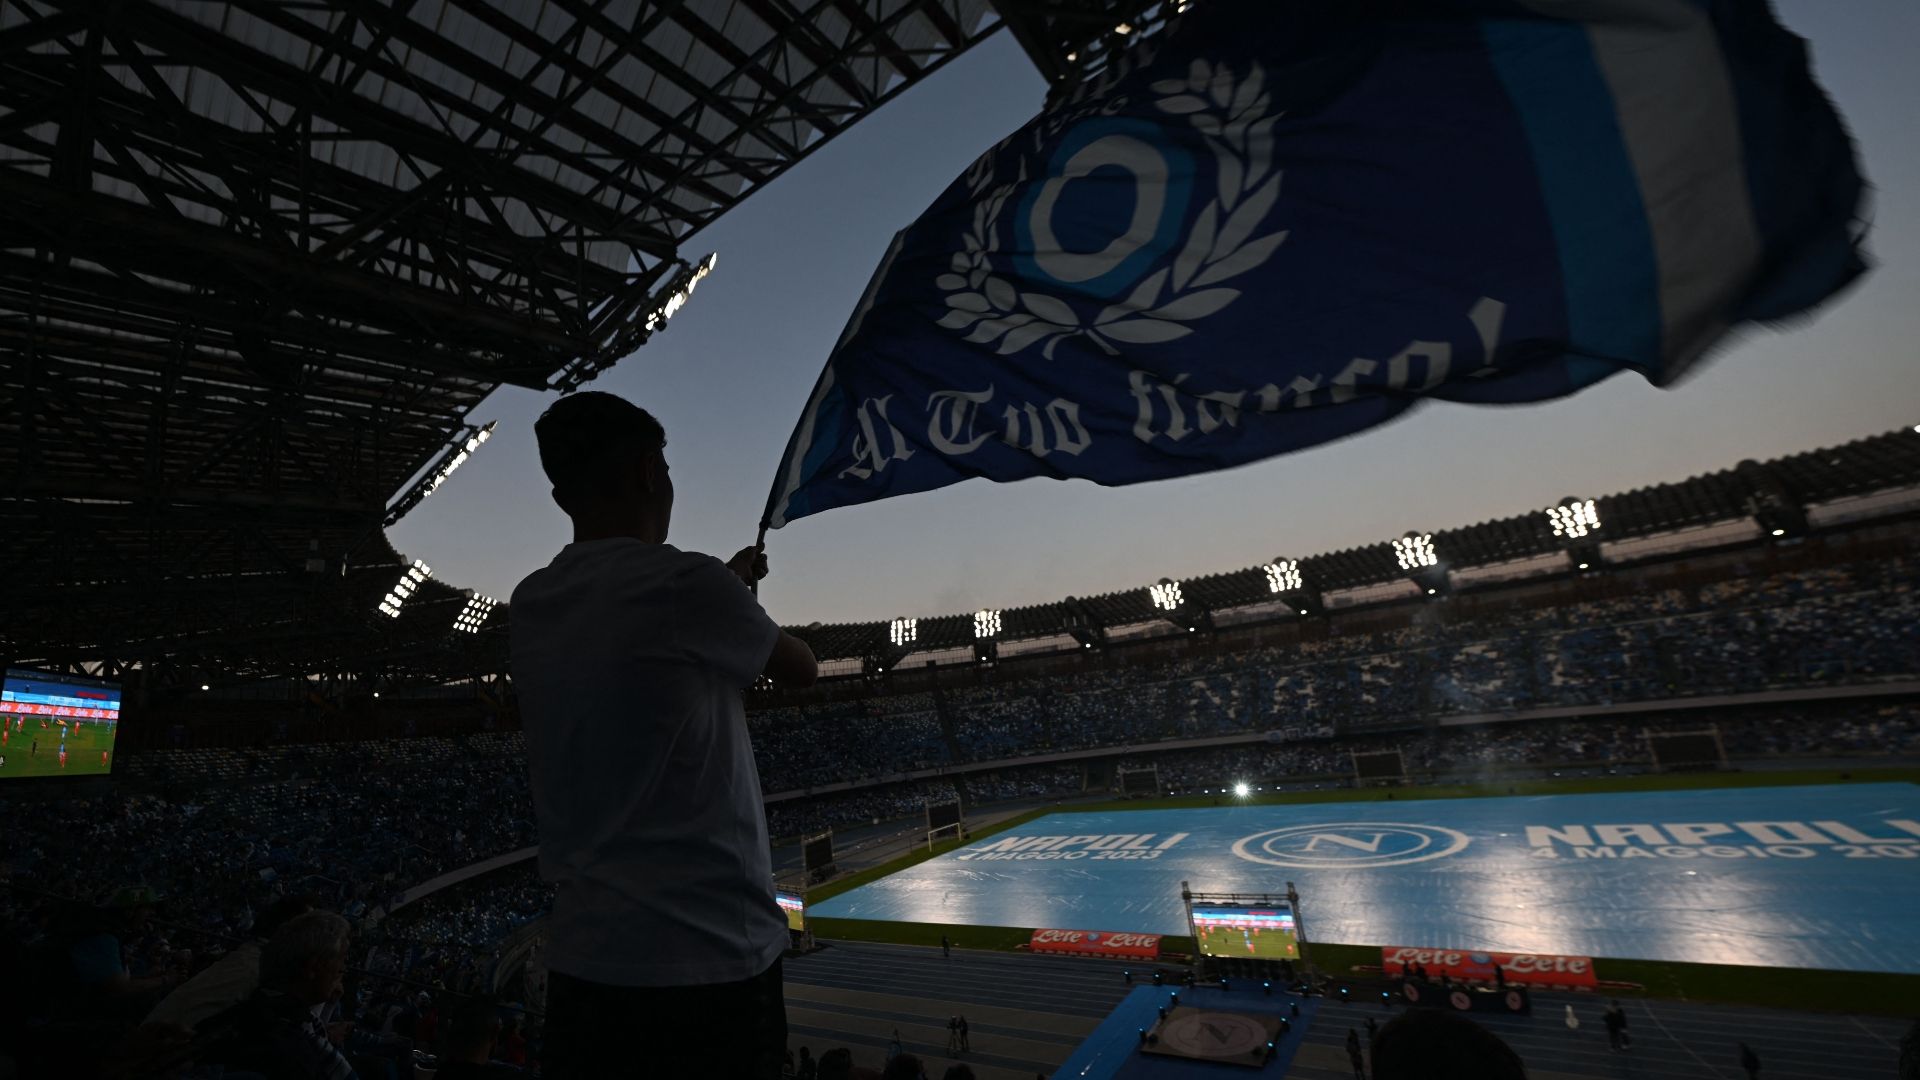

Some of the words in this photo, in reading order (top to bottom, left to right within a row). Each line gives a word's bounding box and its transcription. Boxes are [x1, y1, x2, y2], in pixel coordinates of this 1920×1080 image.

[838, 394, 915, 480] Al
[925, 382, 1093, 457] Tuo
[976, 832, 1190, 852] NAPOLI
[1292, 833, 1394, 853] N
[1530, 846, 1560, 859] 4
[1575, 845, 1818, 859] MAGGIO
[1829, 844, 1920, 858] 20
[975, 851, 1088, 861] MAGGIO
[1090, 849, 1163, 860] 2023
[1033, 929, 1082, 943] Lete
[1103, 933, 1155, 948] Lete
[1384, 948, 1461, 966] Lete
[1502, 954, 1587, 974] Lete
